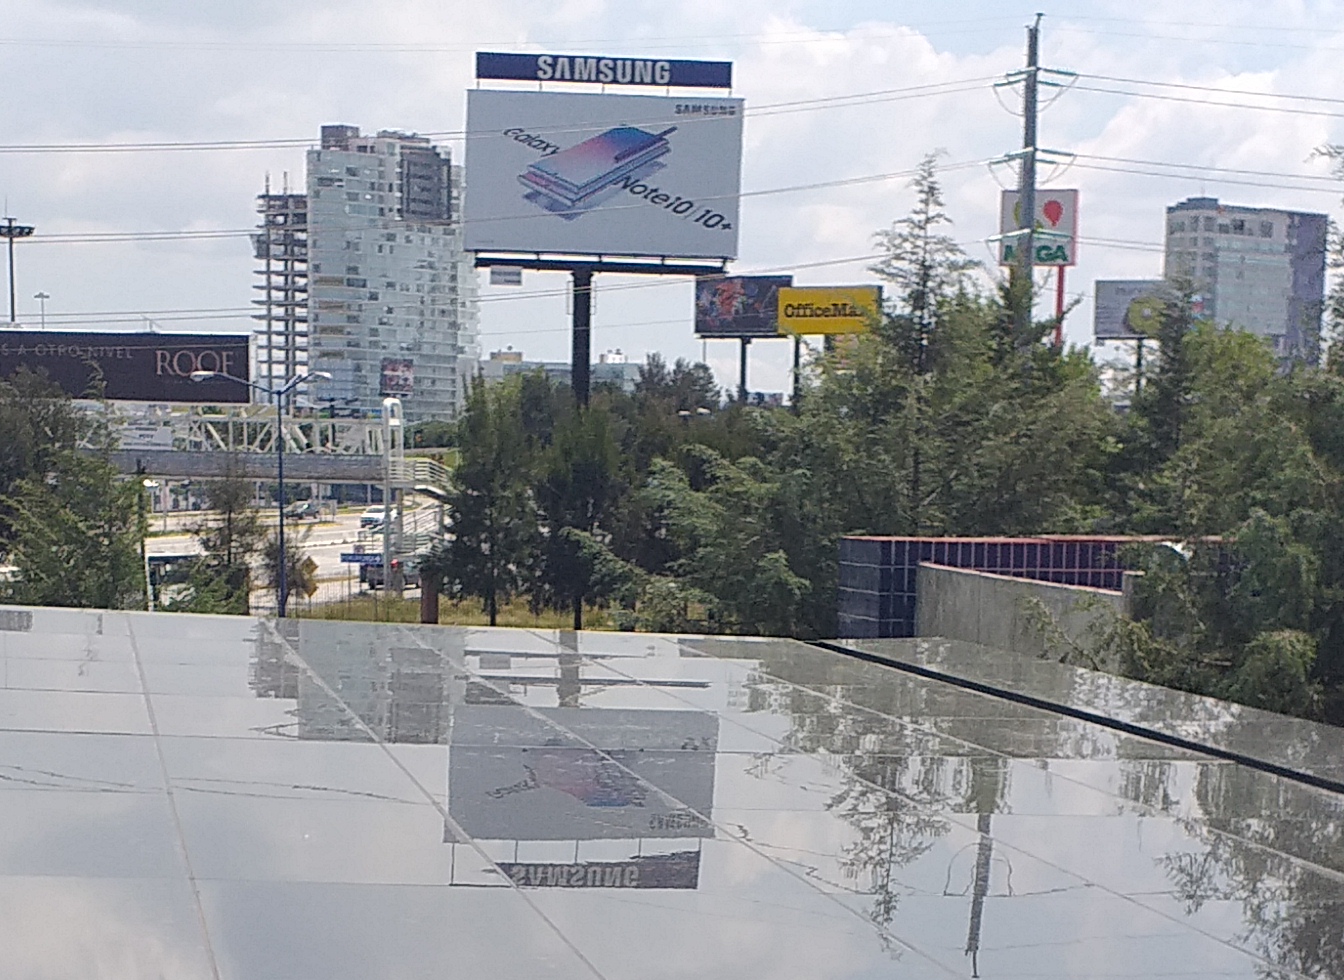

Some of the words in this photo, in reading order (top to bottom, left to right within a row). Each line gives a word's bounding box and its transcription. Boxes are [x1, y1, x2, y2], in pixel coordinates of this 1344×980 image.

[537, 55, 671, 84] SAMSUNG
[674, 103, 737, 116] SAMSUNG
[502, 128, 560, 157] Galaxy
[693, 208, 732, 231] 10+
[1003, 244, 1068, 262] MGA
[784, 303, 866, 318] OfficeMa
[17, 344, 27, 356] A
[87, 346, 133, 359] NIVEL
[156, 350, 234, 377] ROOF
